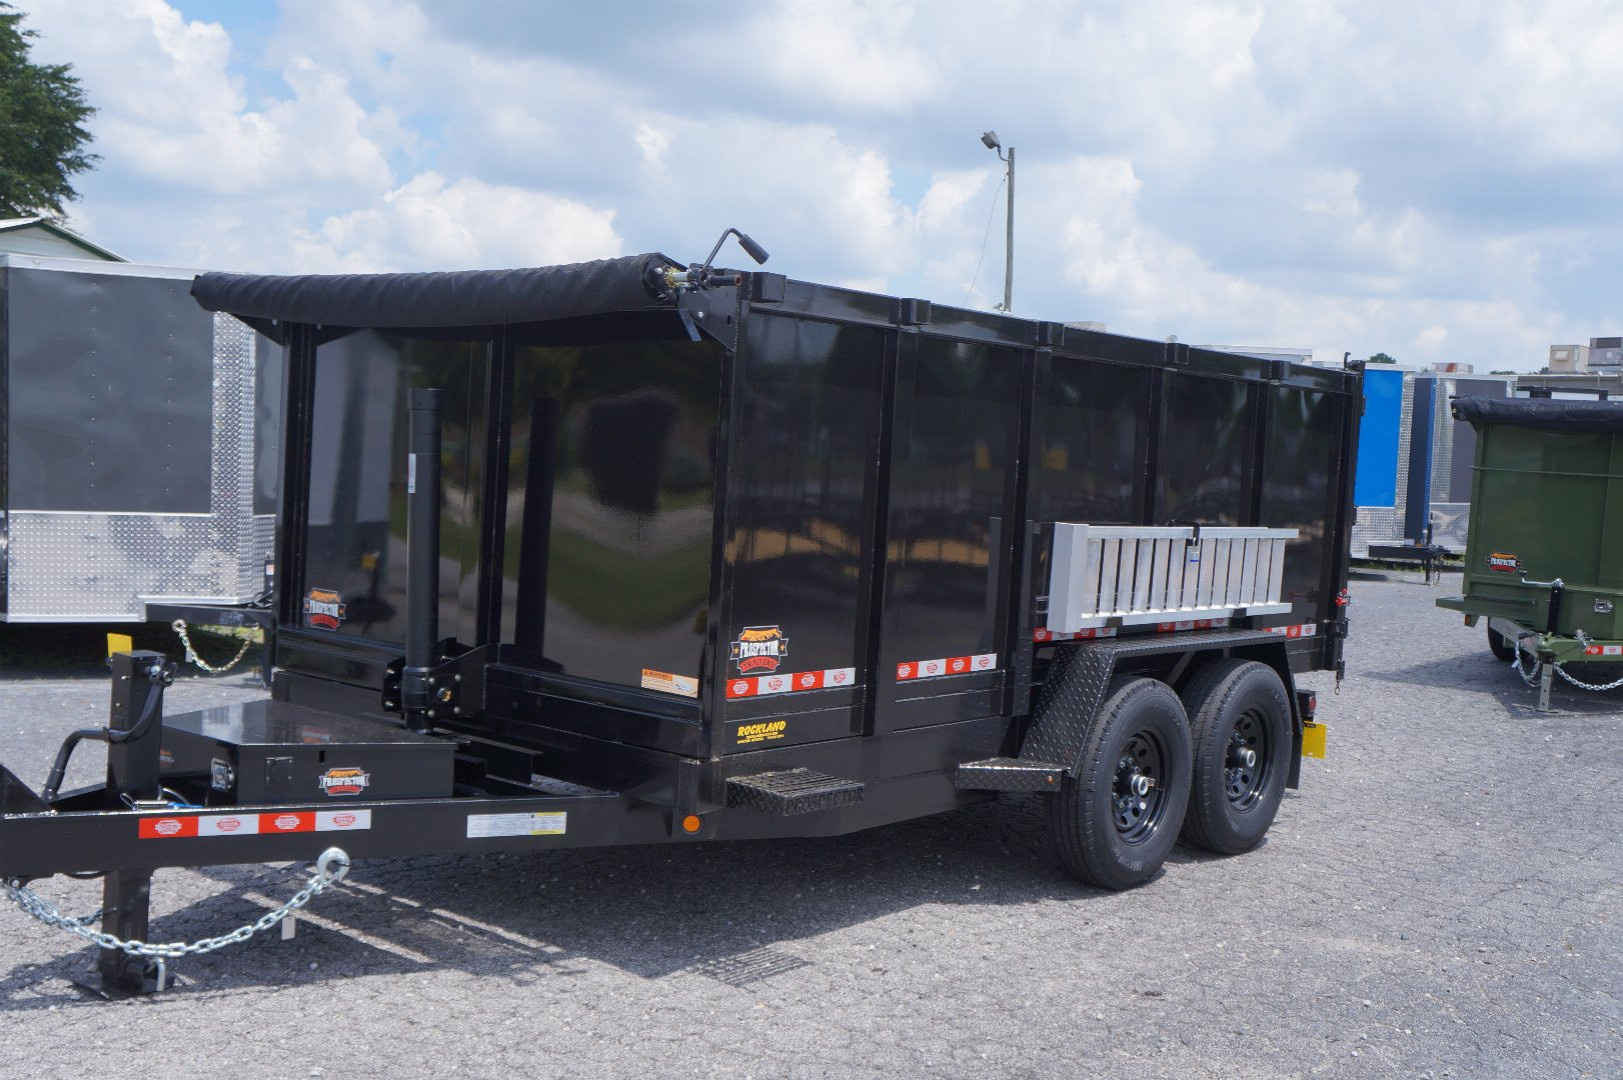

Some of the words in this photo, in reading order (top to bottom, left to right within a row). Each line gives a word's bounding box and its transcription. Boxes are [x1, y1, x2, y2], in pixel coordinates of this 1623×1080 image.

[740, 640, 779, 658] PROSPECTOR
[737, 720, 786, 736] ROCKLAND
[323, 776, 366, 787] PROSPECTOR
[785, 787, 864, 814] PROSPECTOR
